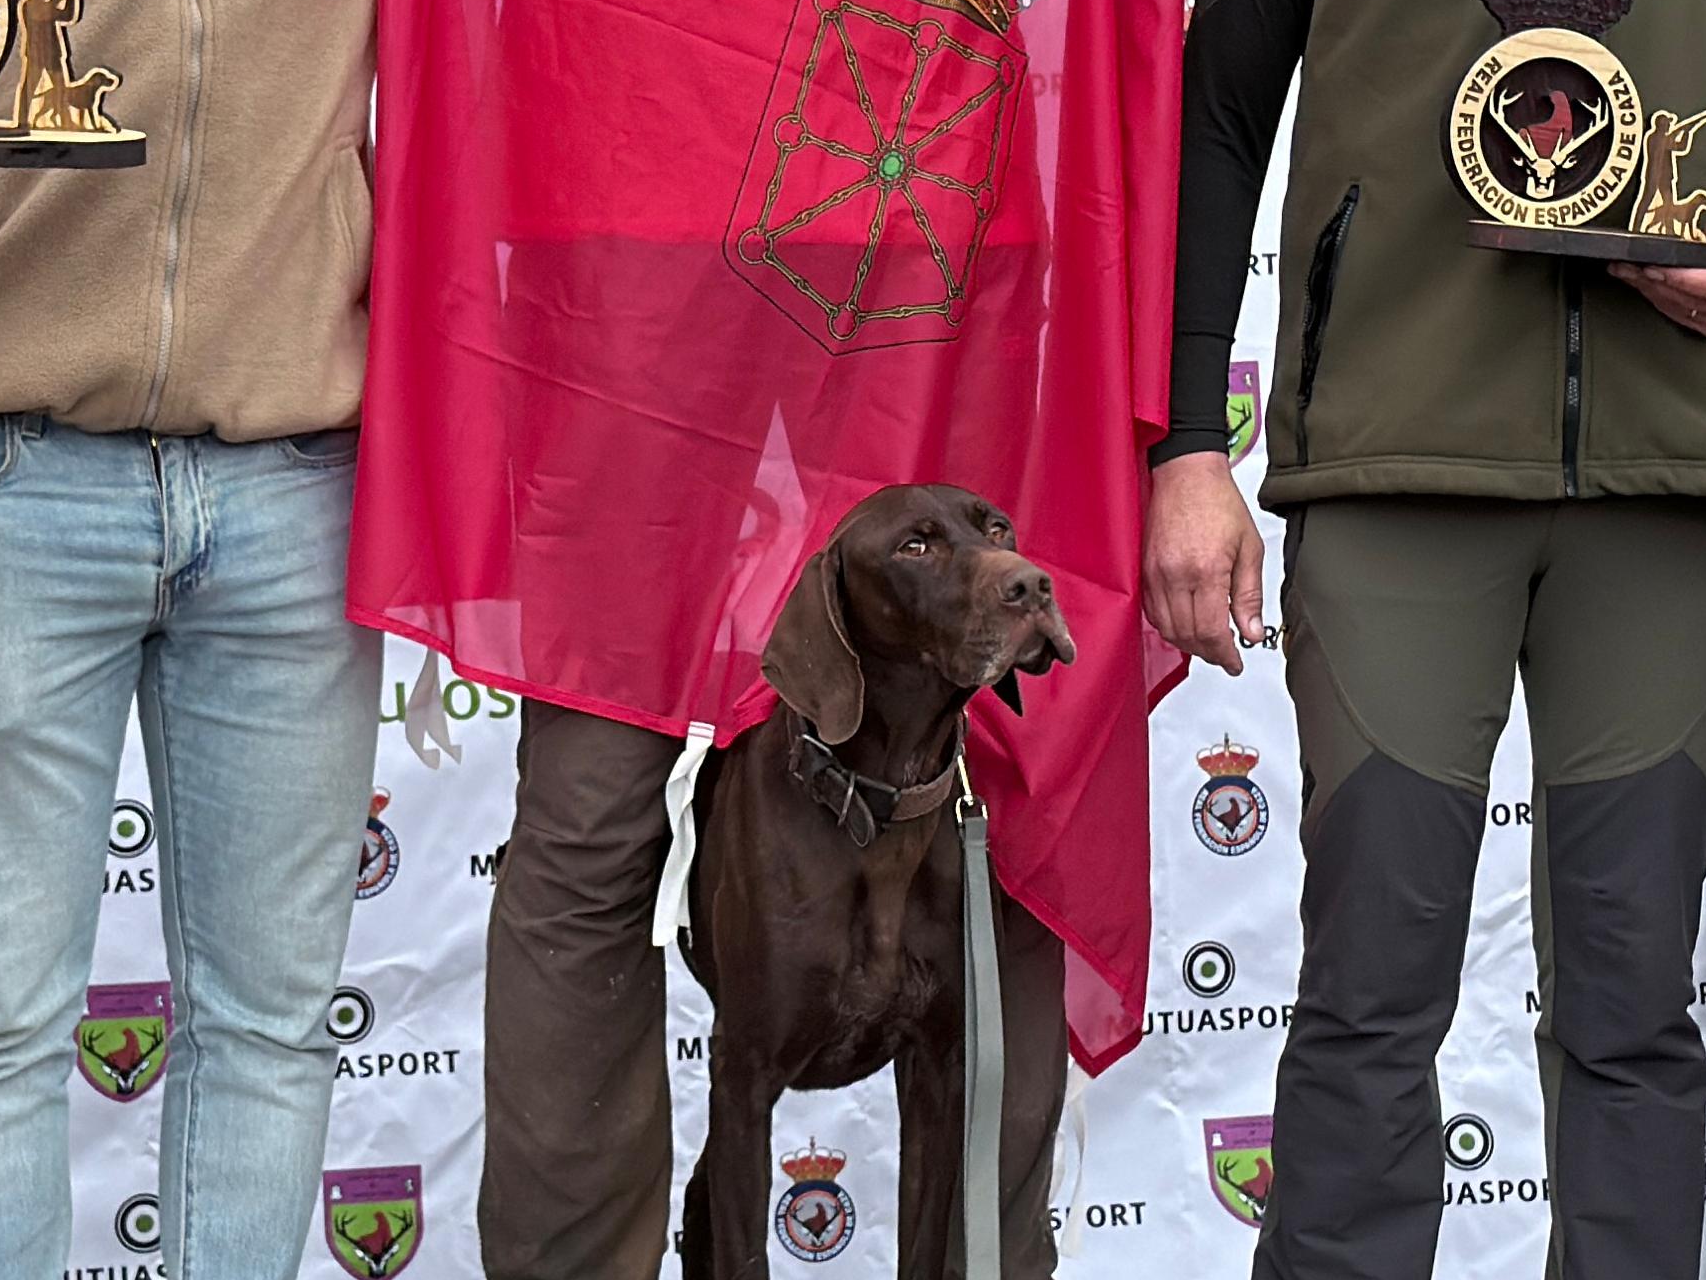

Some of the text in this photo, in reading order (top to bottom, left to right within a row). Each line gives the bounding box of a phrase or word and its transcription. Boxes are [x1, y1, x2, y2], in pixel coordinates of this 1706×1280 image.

[1457, 56, 1636, 225] REAL FEDERACIÓN ESPAÑOLA DE CAZA
